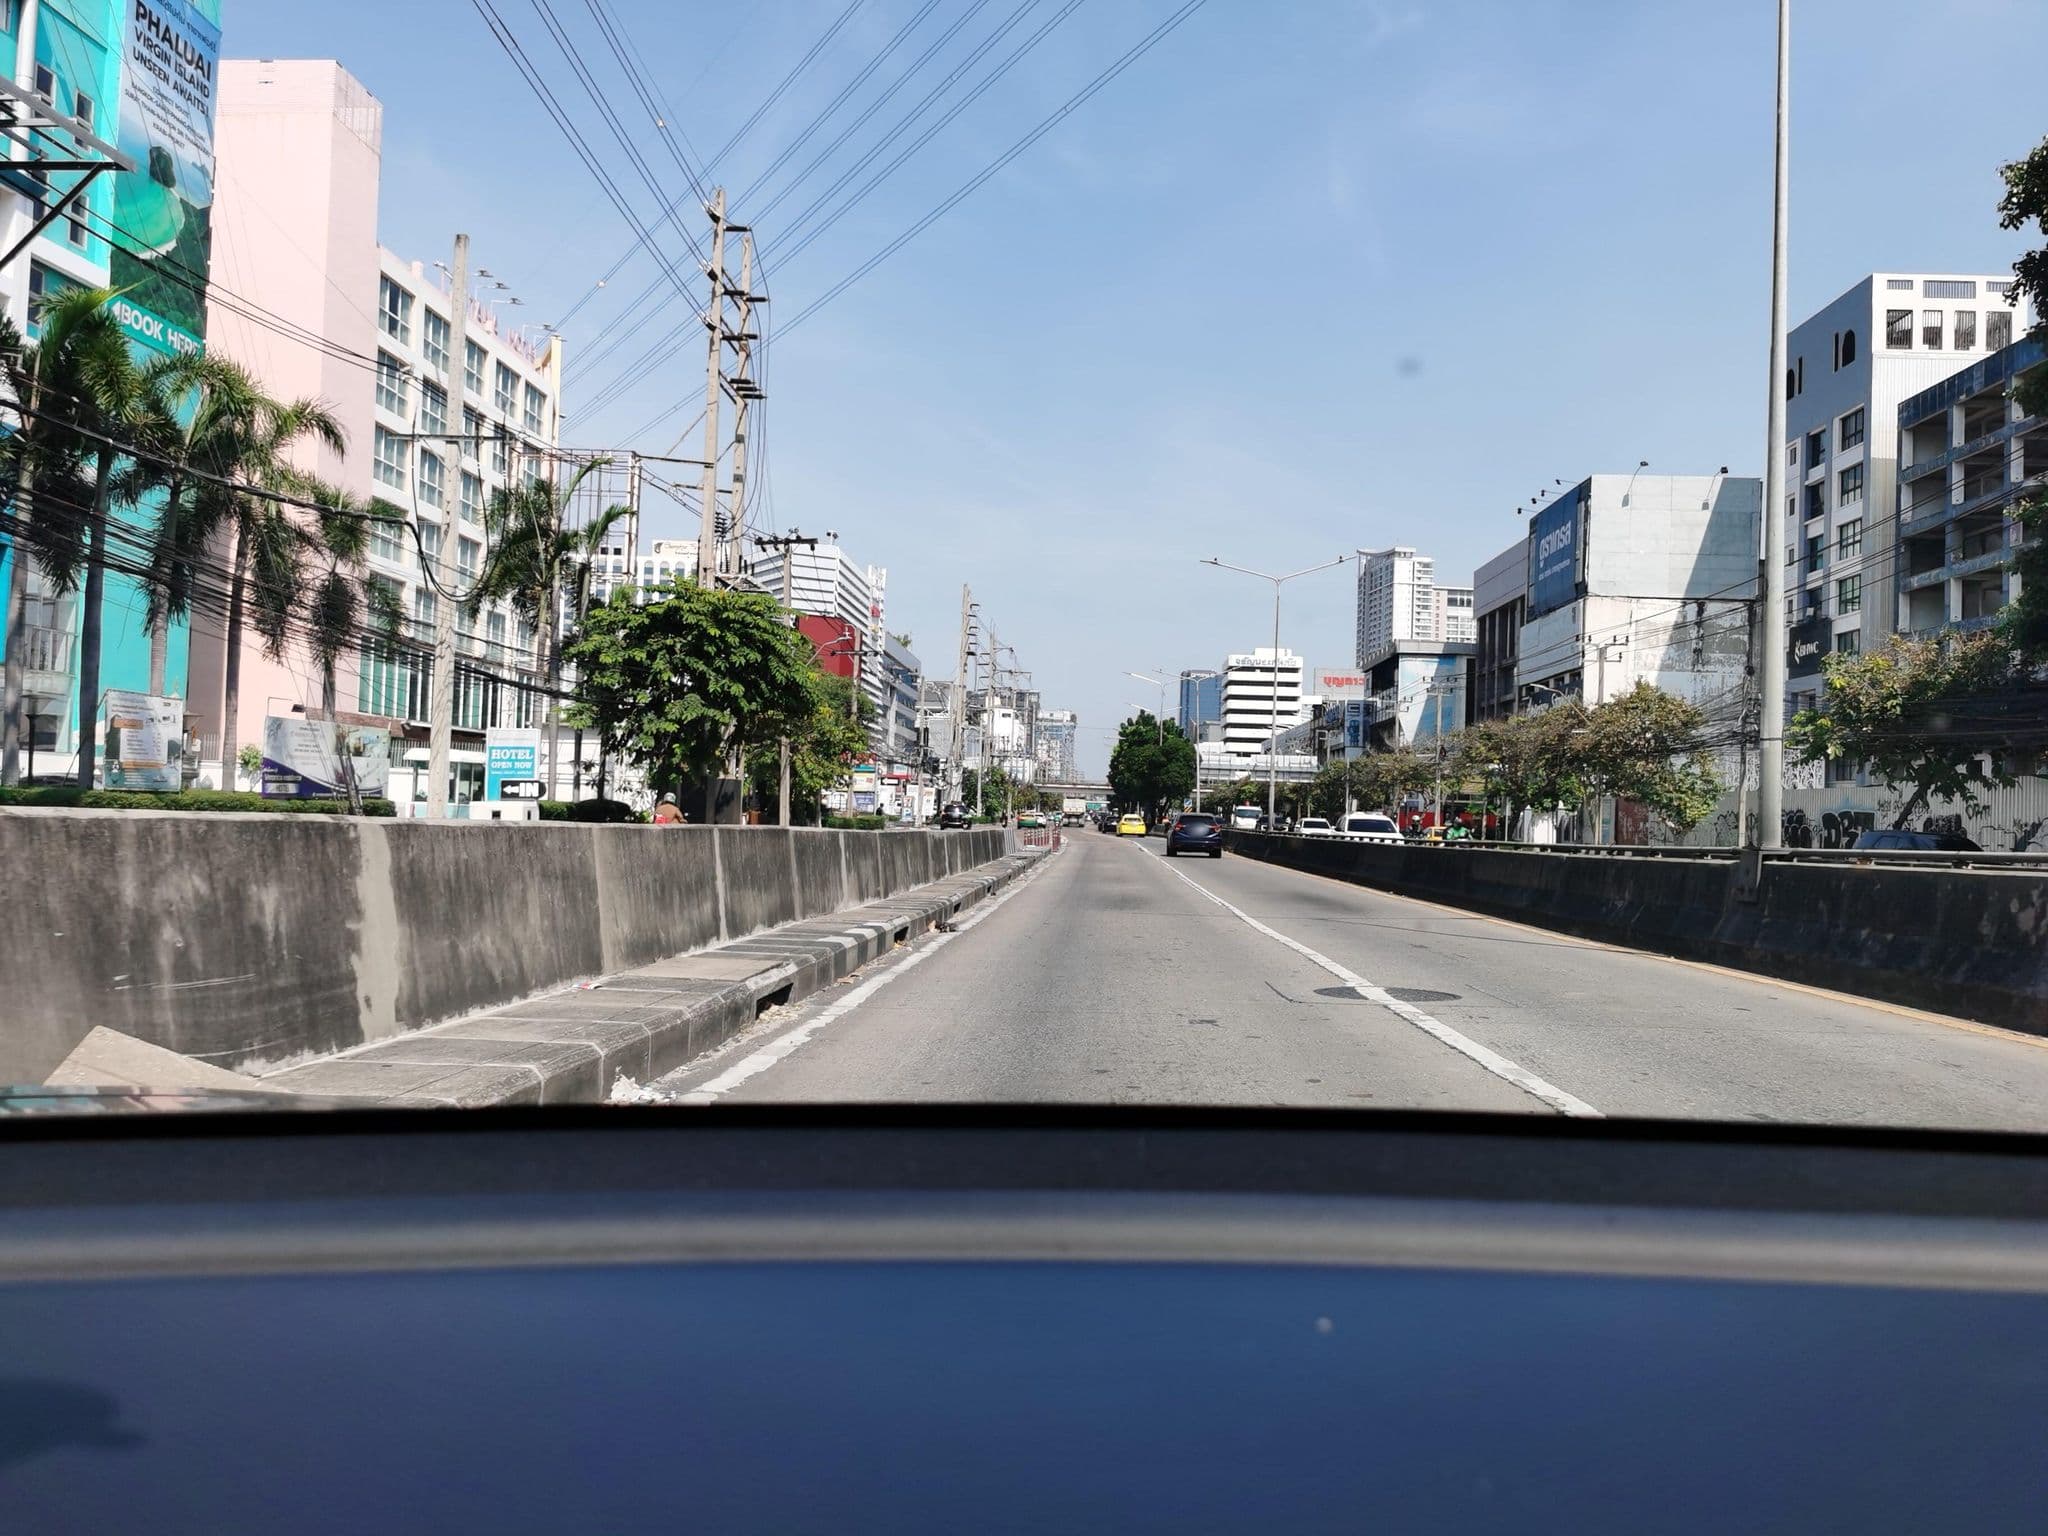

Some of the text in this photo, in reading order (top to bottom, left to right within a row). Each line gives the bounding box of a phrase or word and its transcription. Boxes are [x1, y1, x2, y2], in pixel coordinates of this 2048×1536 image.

[135, 0, 211, 83] PHALUAI
[132, 45, 170, 86] UNSEEN
[172, 79, 209, 117] AWAITS!
[134, 25, 172, 68] VIRGIN
[174, 60, 210, 98] ISLAND
[121, 303, 164, 342] BOOK
[491, 749, 534, 760] HOTEL
[491, 761, 533, 769] OPEN NOW
[519, 782, 539, 798] IN
